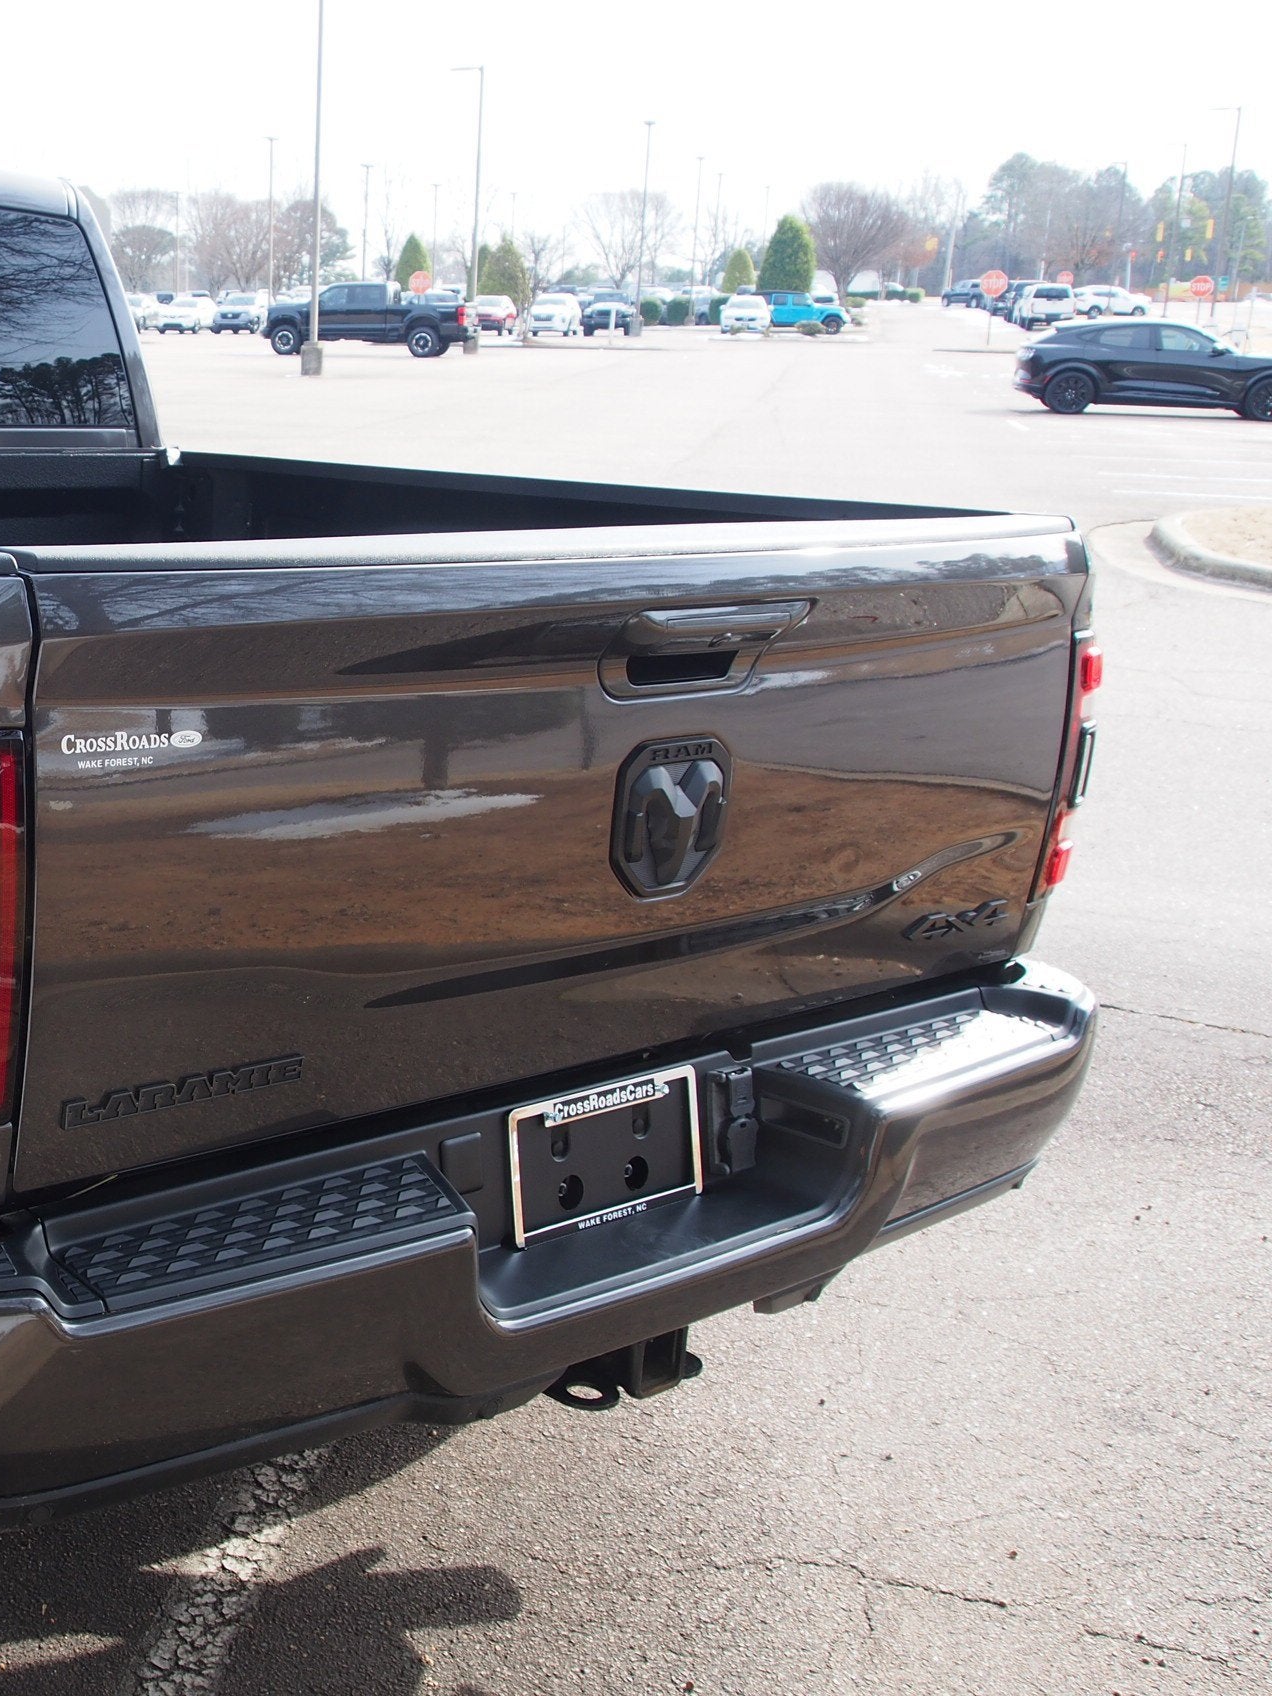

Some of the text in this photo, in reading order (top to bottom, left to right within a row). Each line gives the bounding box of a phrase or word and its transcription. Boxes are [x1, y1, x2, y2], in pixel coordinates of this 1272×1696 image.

[983, 278, 1005, 289] STOP
[1191, 282, 1212, 291] STOP
[650, 743, 713, 761] RAM
[78, 756, 154, 769] WAKE FOREST, NC
[61, 1053, 305, 1130] LARAMIE
[554, 1083, 655, 1119] CrossRoadsCars
[578, 1203, 648, 1230] WAKE FOREST, NC
